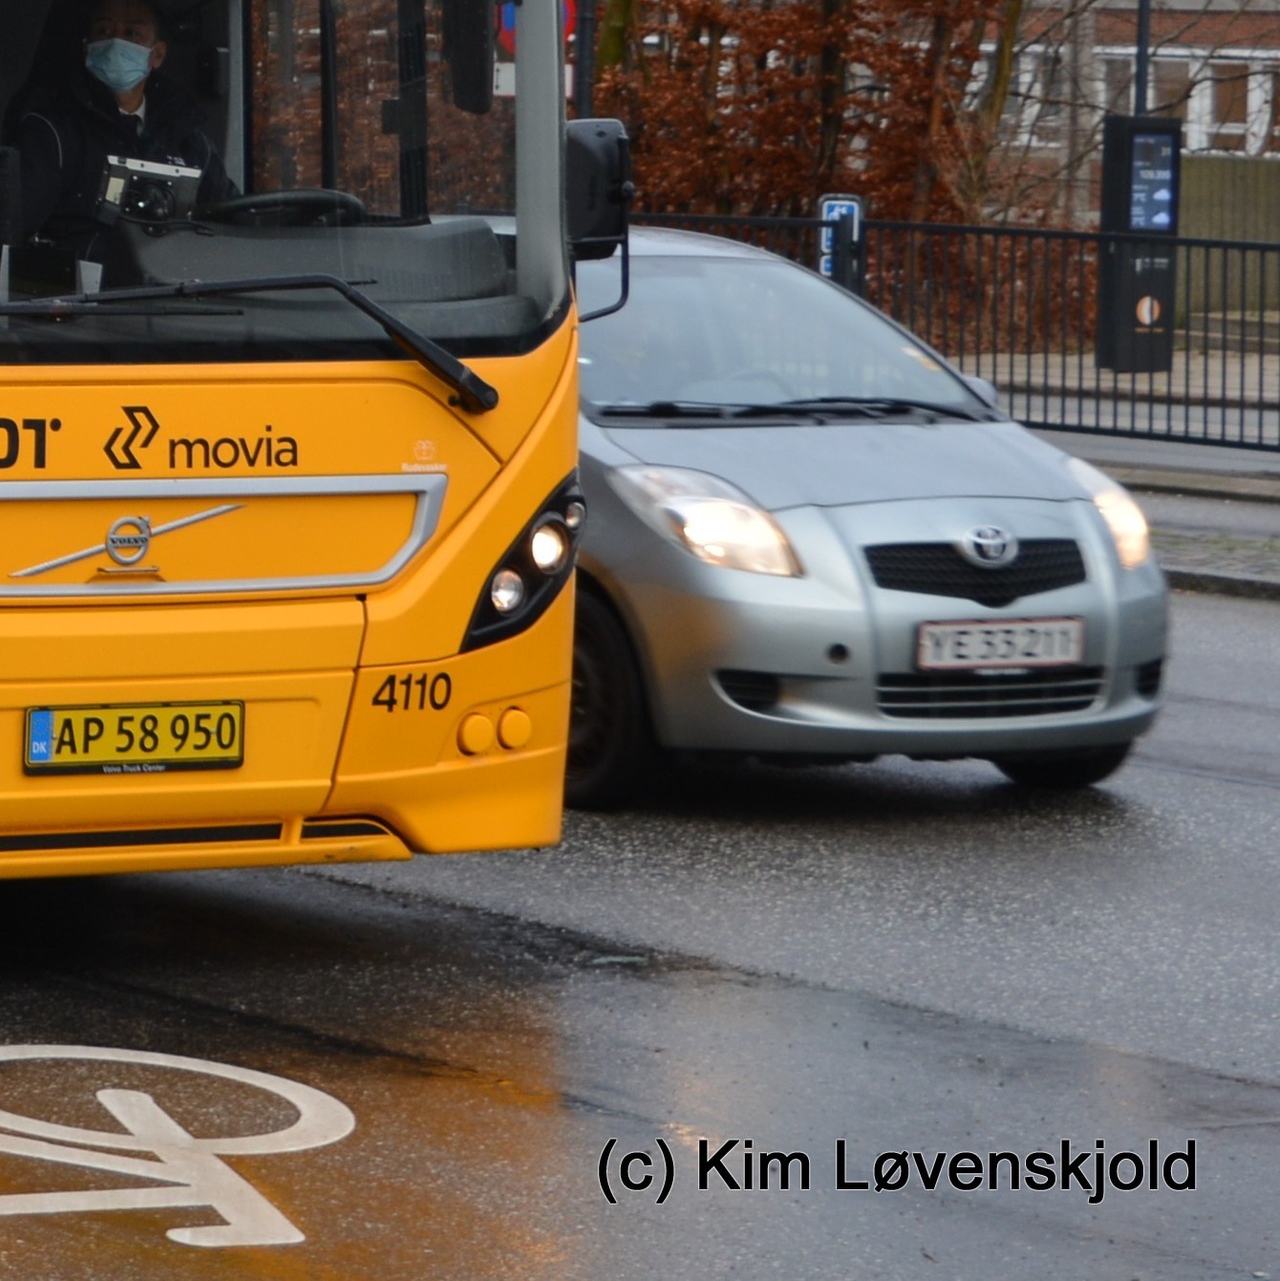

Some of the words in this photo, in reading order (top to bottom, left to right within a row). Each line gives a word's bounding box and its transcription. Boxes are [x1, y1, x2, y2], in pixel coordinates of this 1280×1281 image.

[169, 425, 298, 469] movia
[109, 536, 148, 545] VOLVO
[372, 672, 452, 712] 4110
[32, 741, 47, 754] DK
[55, 717, 105, 755] AP
[115, 714, 159, 753] 58
[170, 712, 236, 752] 950
[123, 764, 141, 772] Truck
